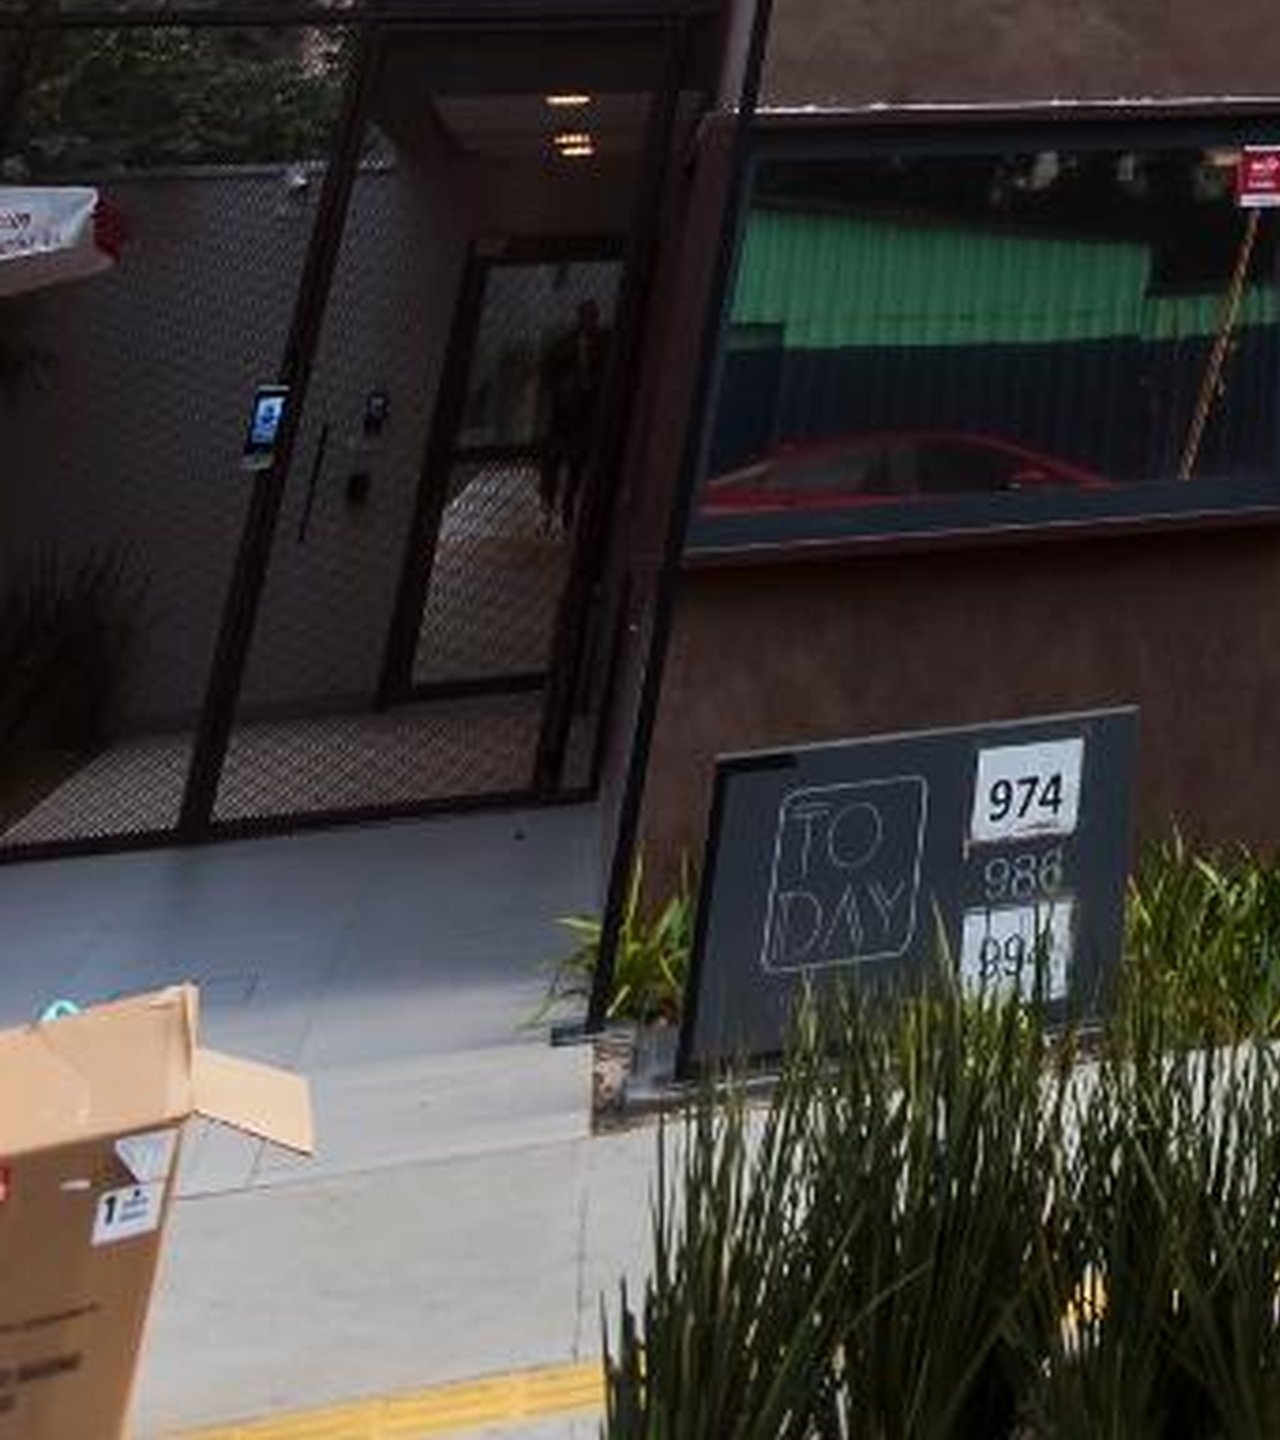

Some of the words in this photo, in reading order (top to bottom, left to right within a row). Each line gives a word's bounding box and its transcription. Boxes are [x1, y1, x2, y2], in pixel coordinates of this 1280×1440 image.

[988, 772, 1064, 822] 974
[789, 799, 883, 878] TO
[771, 879, 906, 963] DAY
